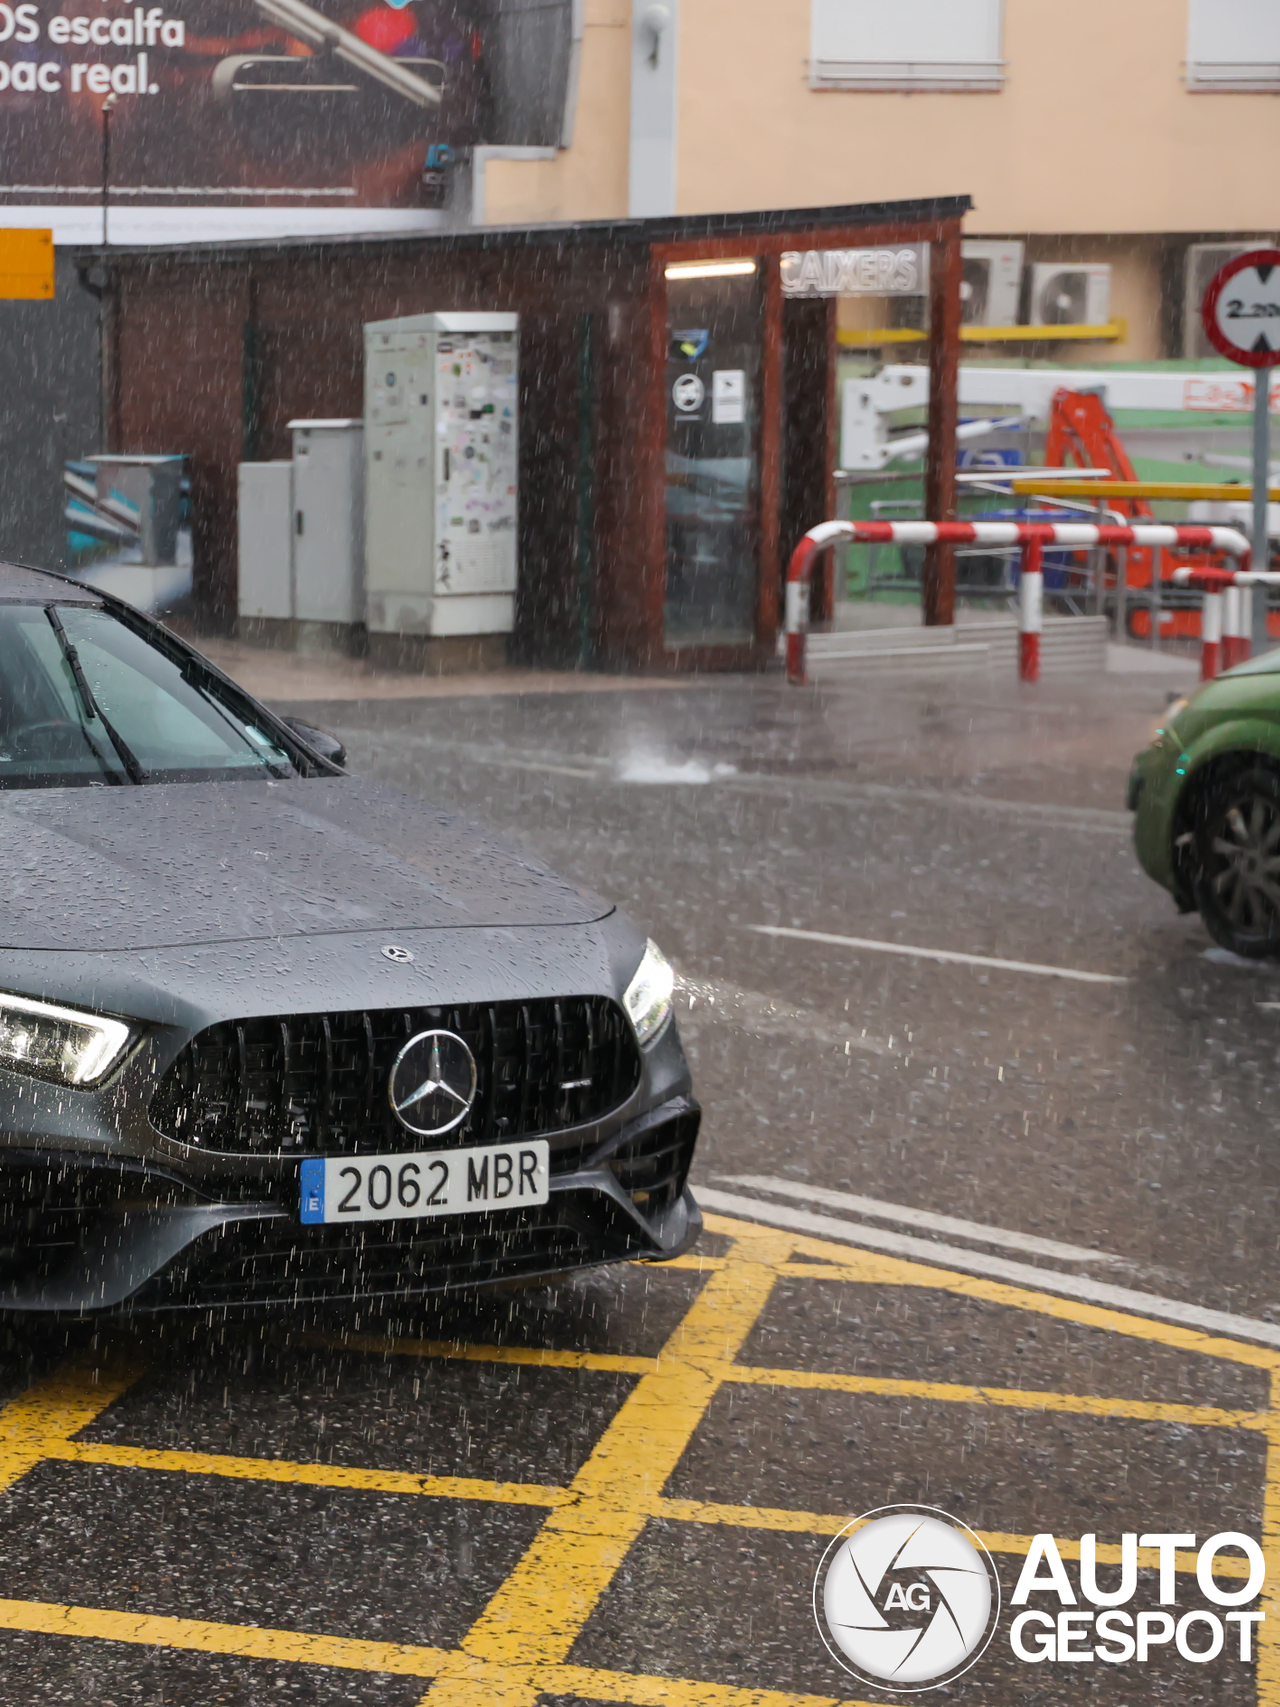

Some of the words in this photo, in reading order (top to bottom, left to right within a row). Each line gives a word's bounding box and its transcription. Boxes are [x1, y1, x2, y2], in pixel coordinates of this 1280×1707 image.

[48, 7, 185, 47] escalfa
[71, 52, 160, 95] real.
[780, 249, 917, 292] CAIXERS
[337, 1160, 449, 1213] 2062
[467, 1150, 538, 1202] MBR
